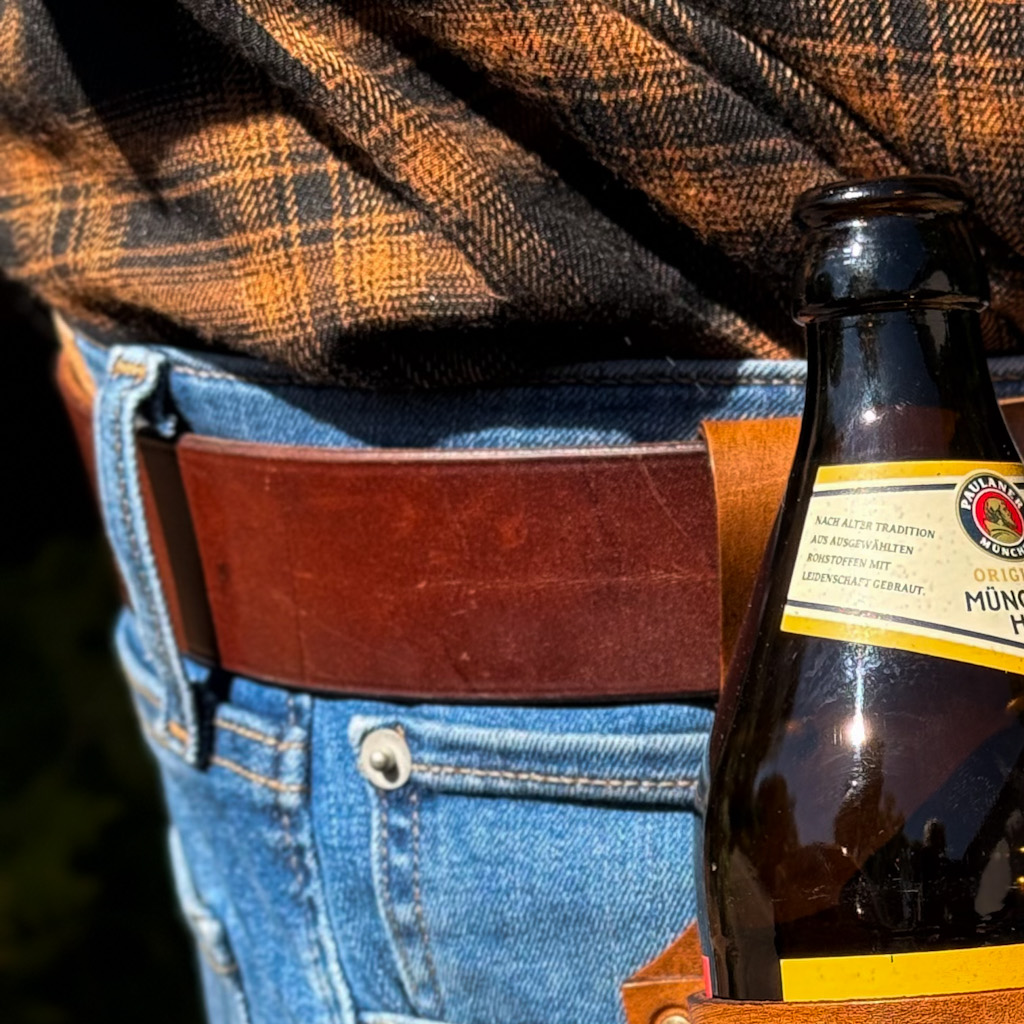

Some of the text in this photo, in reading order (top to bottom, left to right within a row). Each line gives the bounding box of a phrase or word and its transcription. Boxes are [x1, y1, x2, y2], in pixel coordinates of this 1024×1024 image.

[960, 477, 1024, 511] PAULANER
[814, 515, 936, 539] NACH ALTER TRADITION
[810, 534, 914, 555] AUS AUSGEWÄHLTEN
[806, 552, 892, 571] ROHSTOFFEN MIT
[802, 571, 926, 596] LEIDENSCHAFT GEBRAUT.
